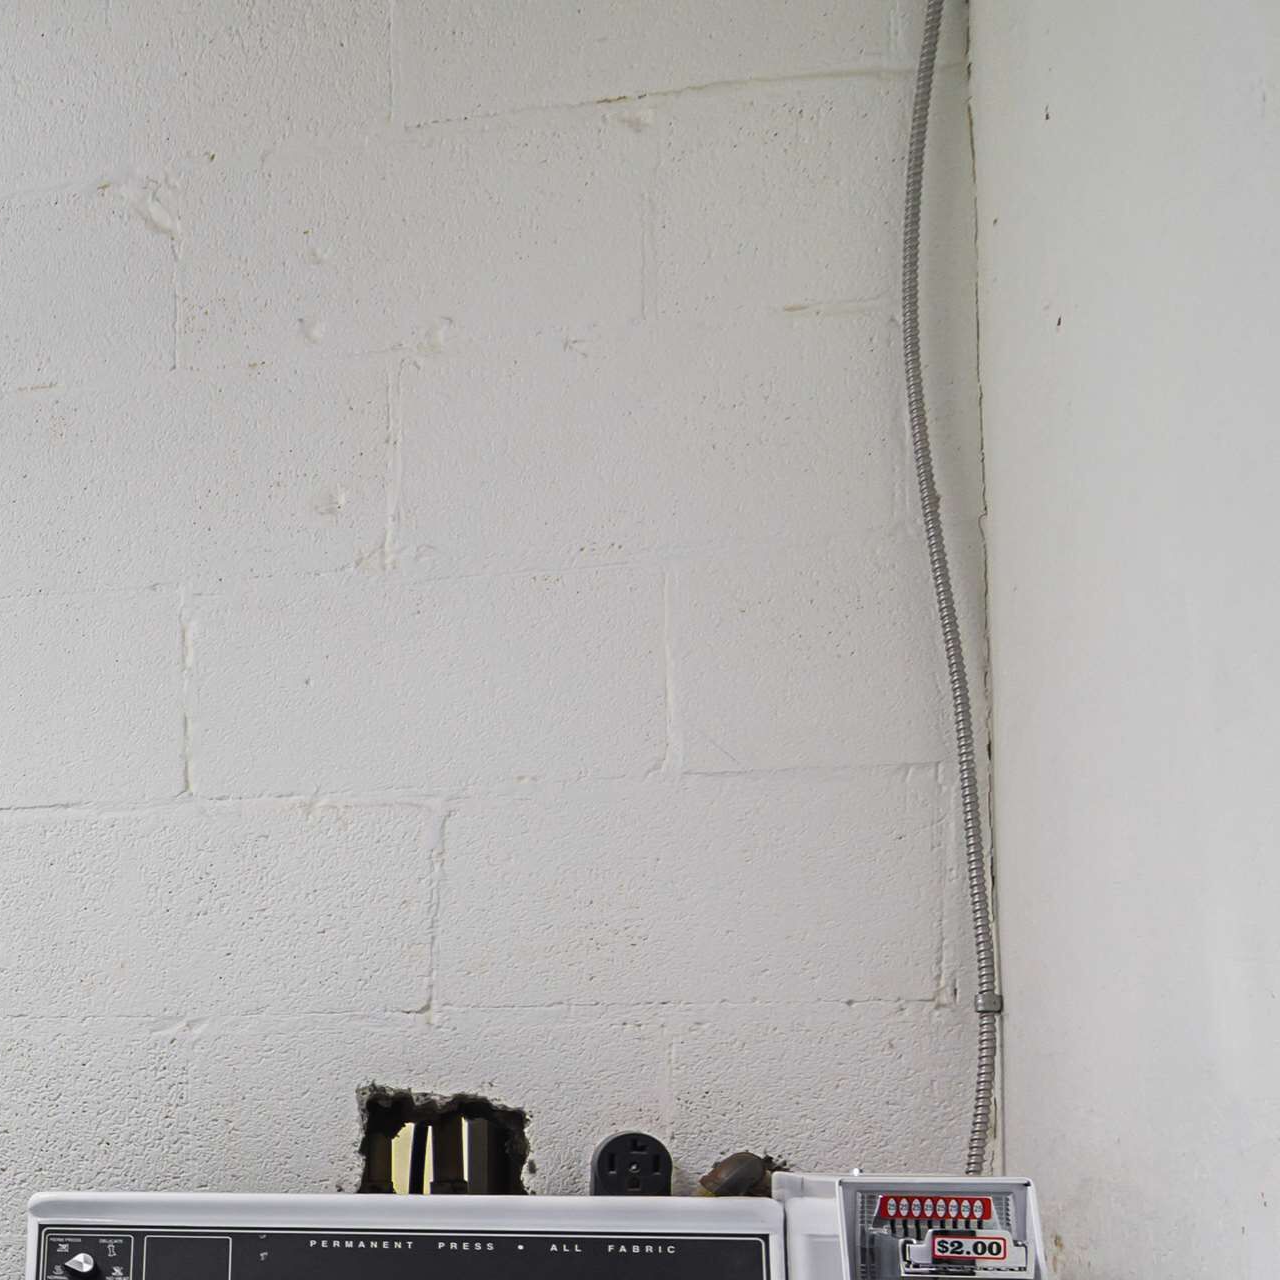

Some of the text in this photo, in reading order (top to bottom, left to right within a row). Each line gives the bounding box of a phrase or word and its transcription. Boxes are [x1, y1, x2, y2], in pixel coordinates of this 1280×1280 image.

[310, 1240, 676, 1254] PERMANENT PRESS ALL FABRIC
[937, 1240, 1002, 1256] $2.00
